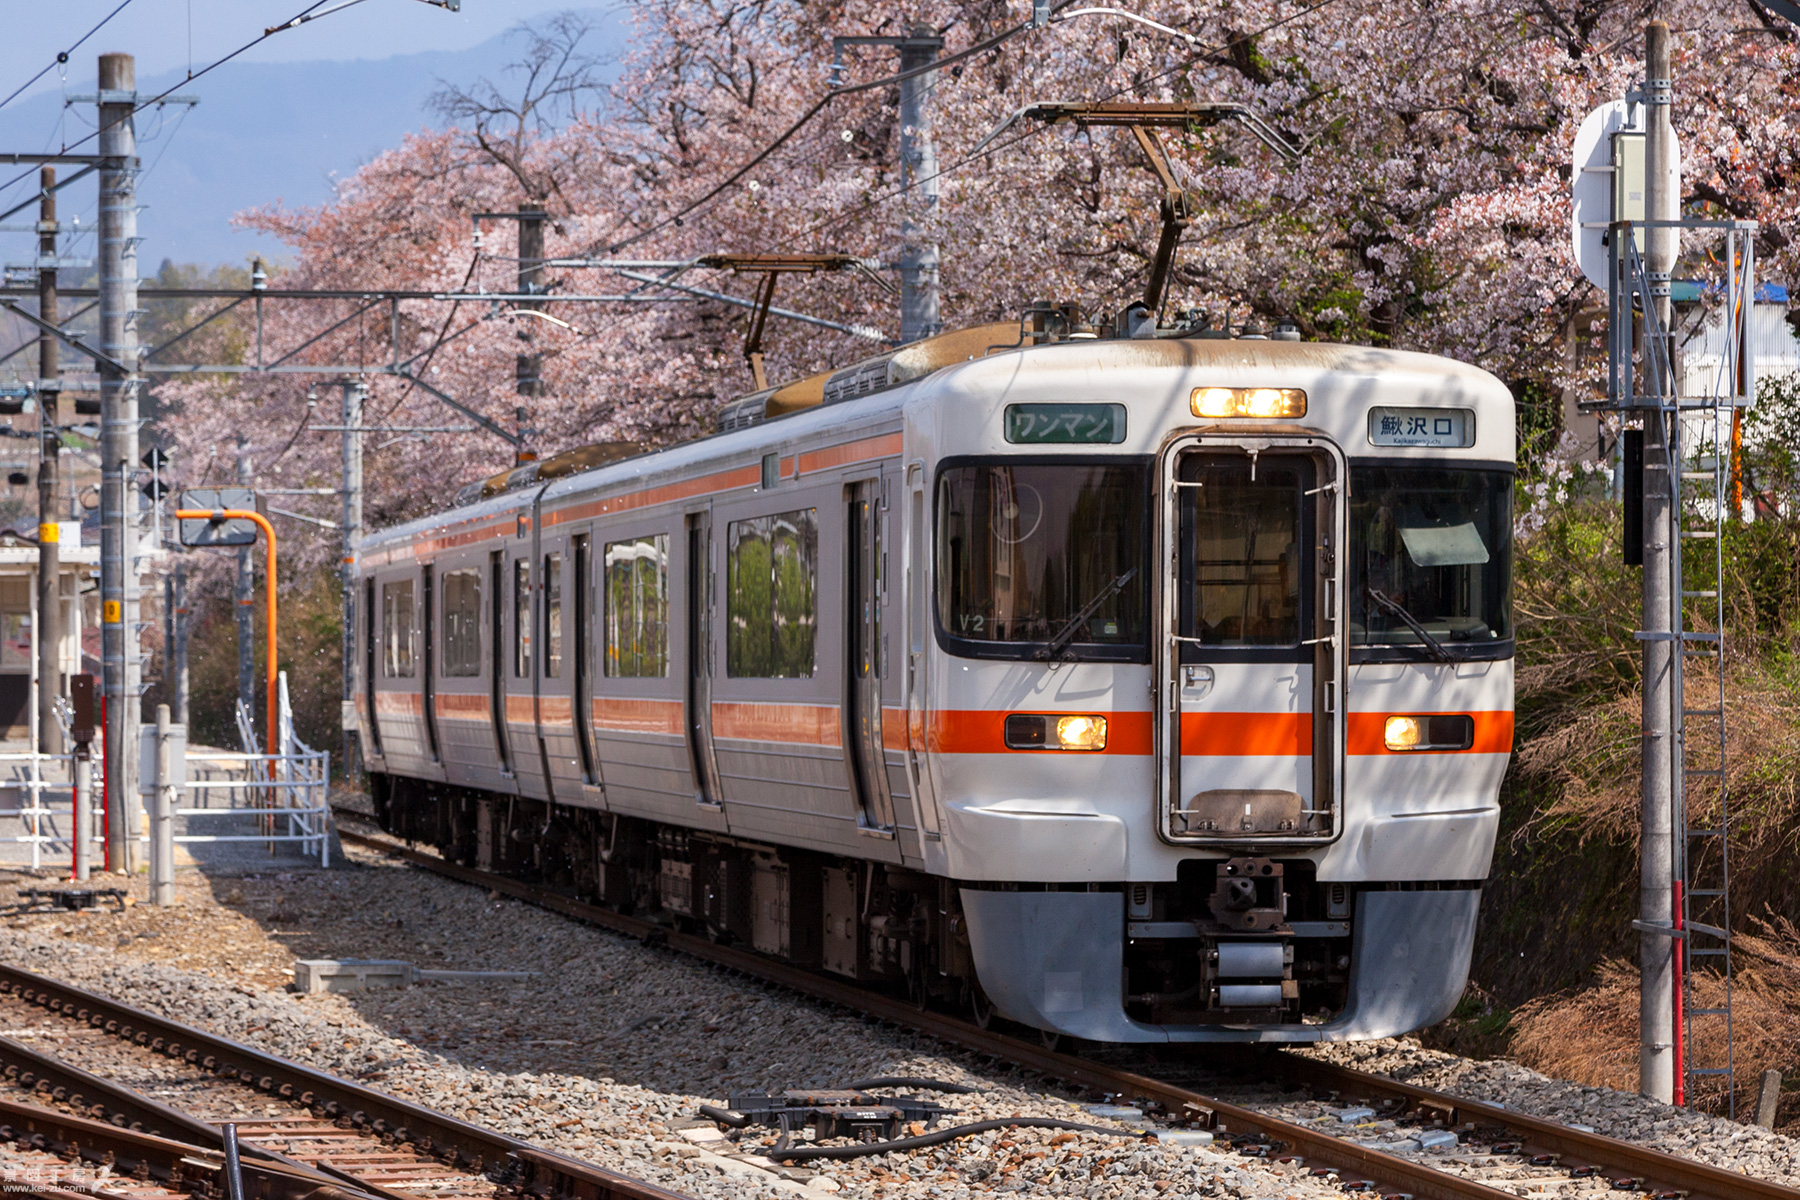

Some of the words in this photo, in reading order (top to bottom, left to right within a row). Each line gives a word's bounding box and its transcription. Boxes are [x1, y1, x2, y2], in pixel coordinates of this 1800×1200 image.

[1016, 413, 1108, 438] ワンマン
[1380, 415, 1452, 436] 鰍沢口
[960, 614, 984, 632] V2
